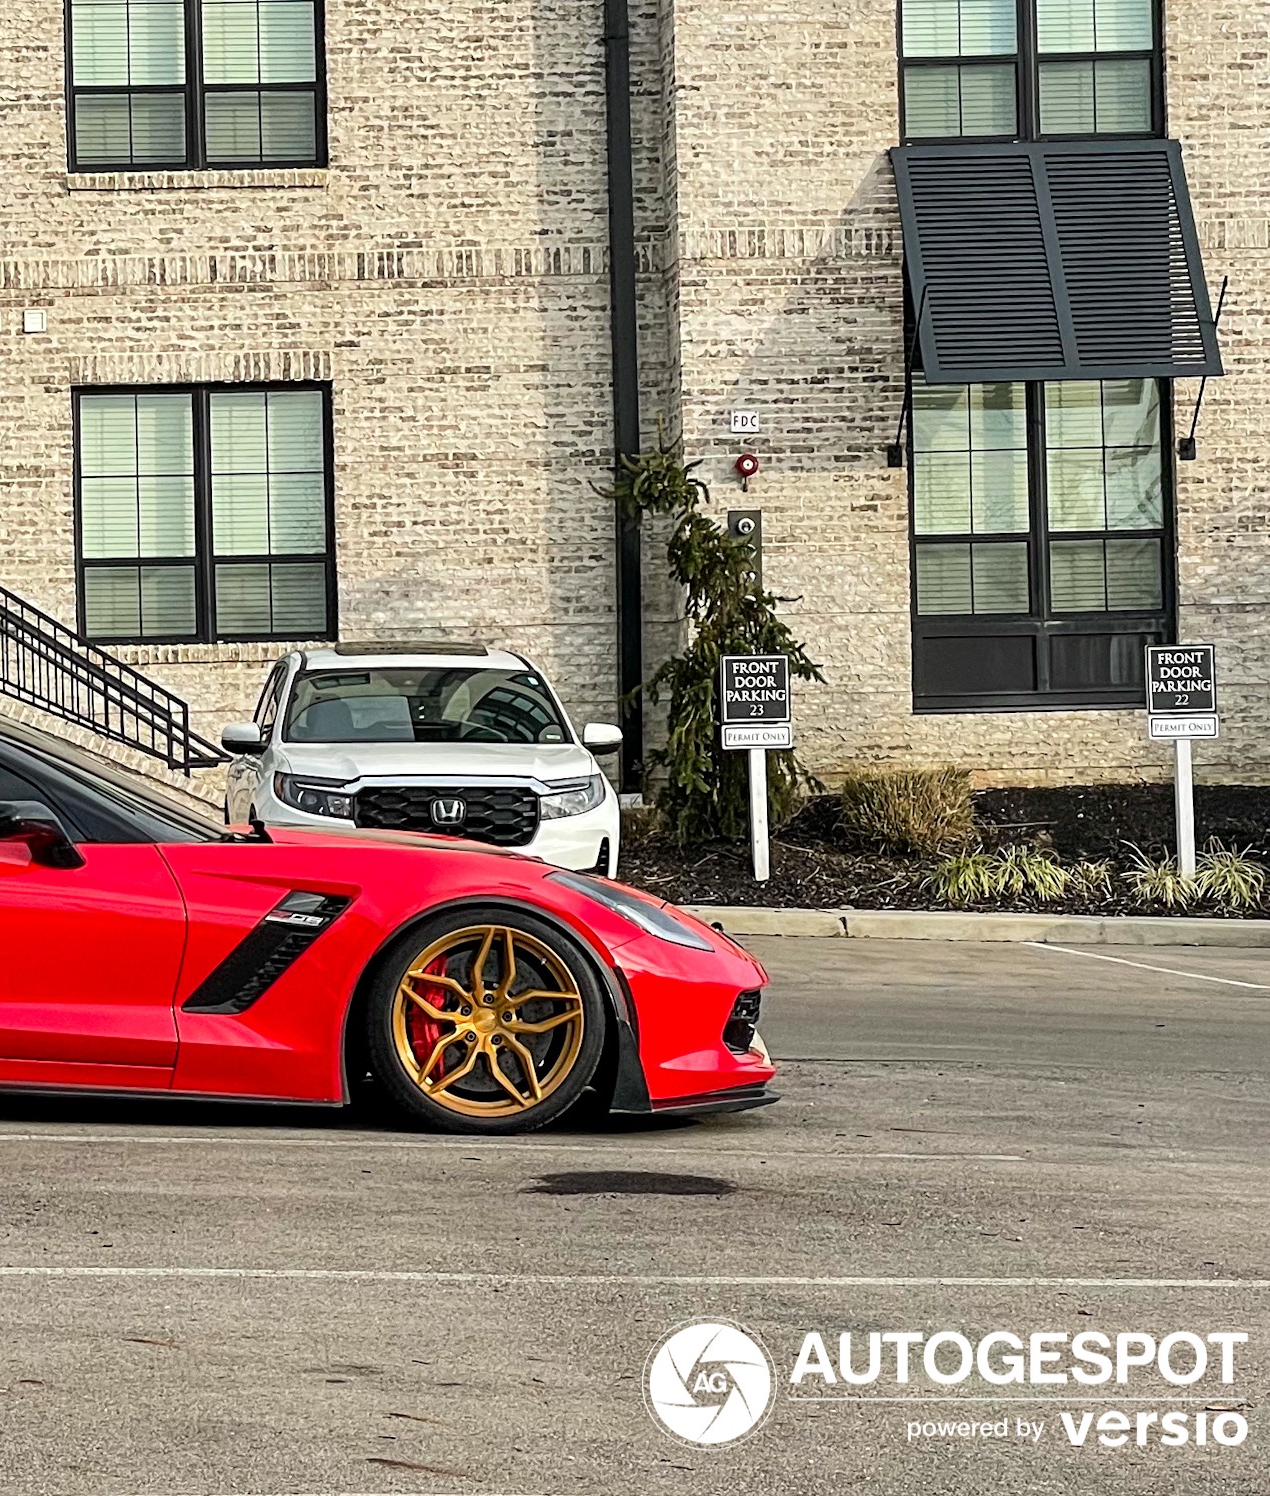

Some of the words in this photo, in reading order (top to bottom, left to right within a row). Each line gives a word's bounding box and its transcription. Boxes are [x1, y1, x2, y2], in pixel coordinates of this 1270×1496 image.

[733, 415, 757, 427] FDC
[1157, 652, 1204, 664] FRONT
[732, 661, 779, 674] FRONT
[1160, 666, 1202, 679] DOOR
[734, 675, 777, 688] DOOR
[1152, 680, 1211, 693] PARKING
[726, 689, 786, 702] PARKING
[1174, 694, 1189, 706] 22
[749, 704, 764, 716] 23
